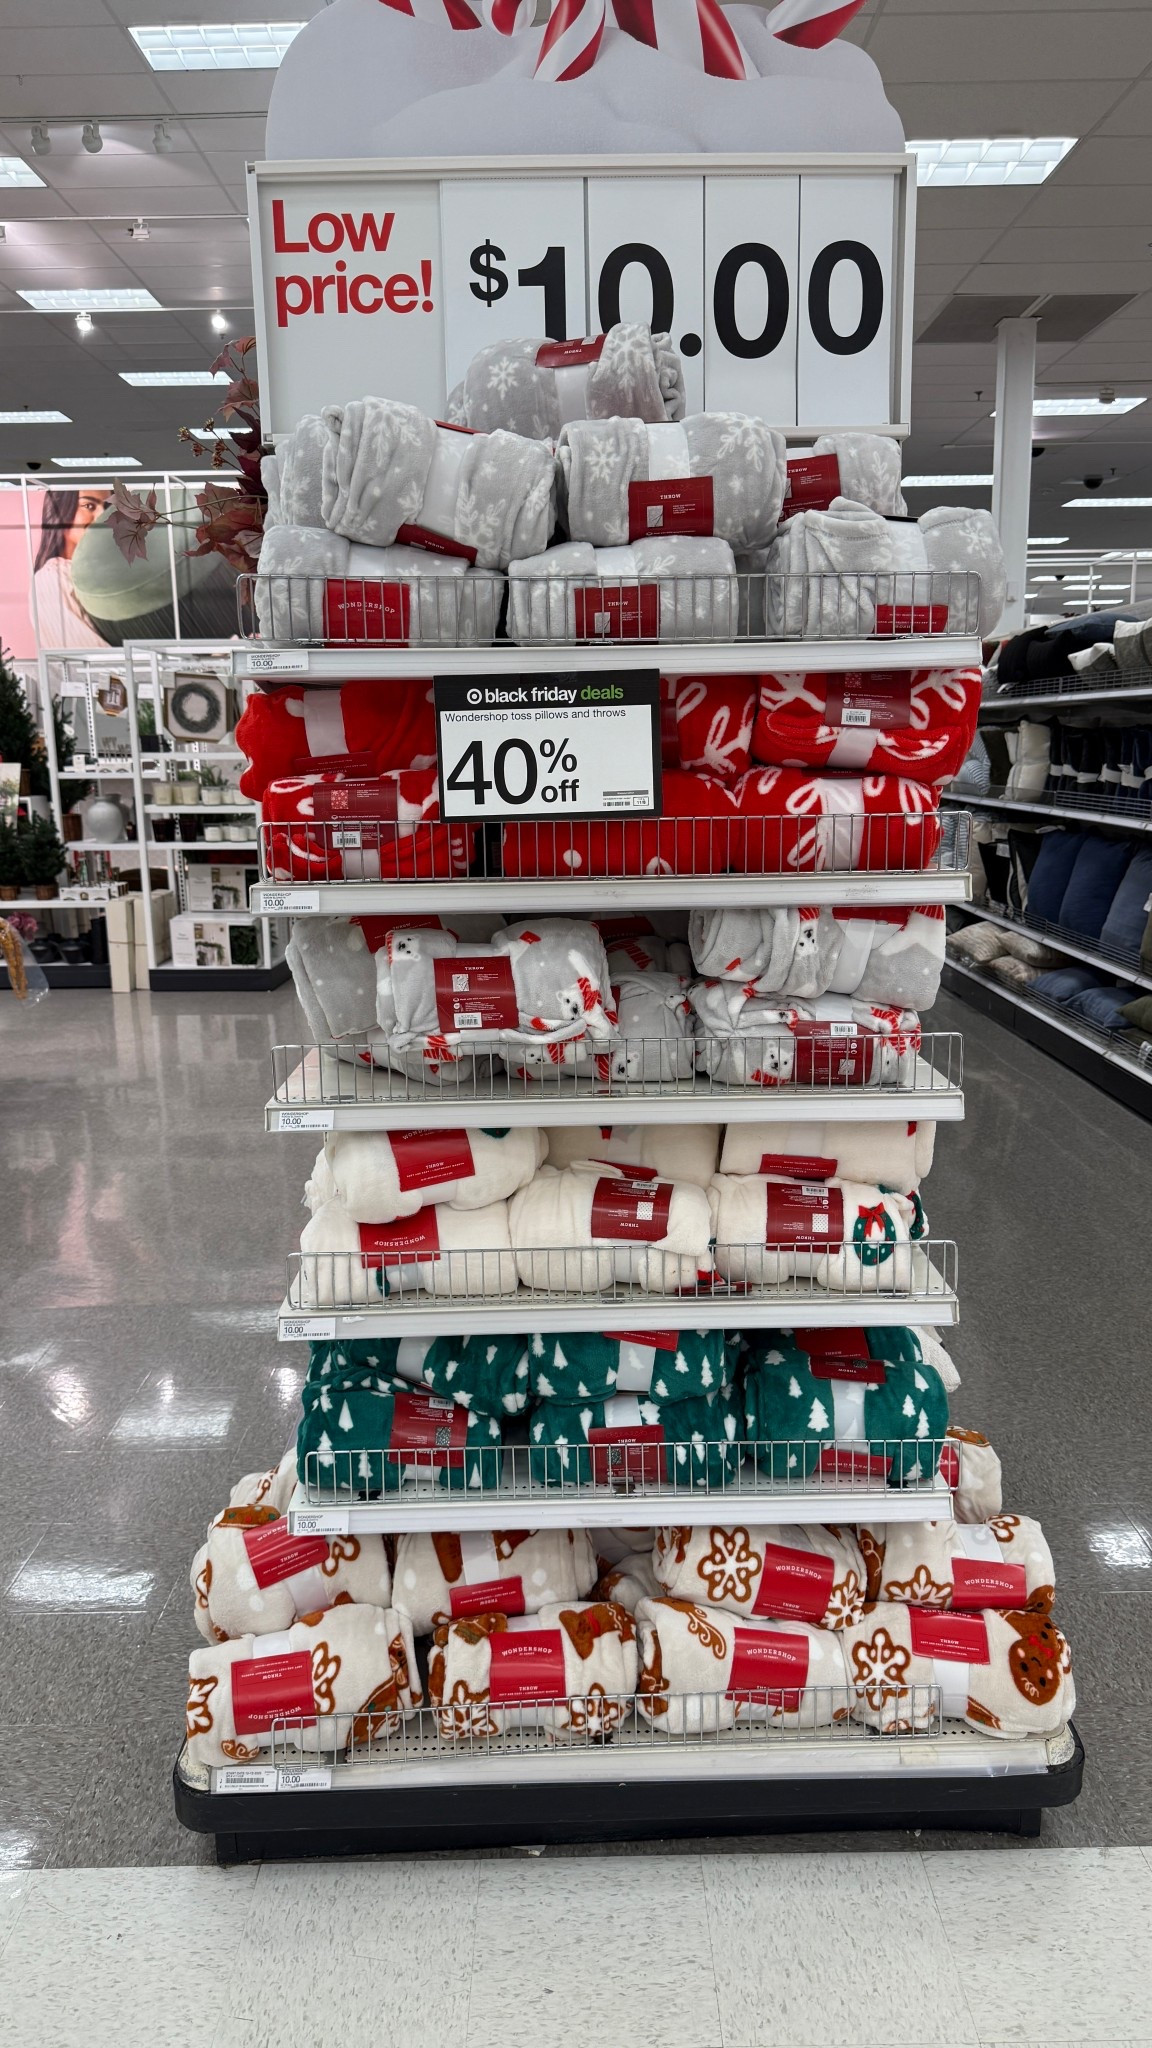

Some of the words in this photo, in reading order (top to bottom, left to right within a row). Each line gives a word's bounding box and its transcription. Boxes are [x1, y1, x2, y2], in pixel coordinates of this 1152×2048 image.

[271, 199, 395, 253] Low
[275, 259, 433, 327] price!
[469, 238, 884, 359] $10.00
[484, 688, 528, 704] black
[530, 686, 578, 704] friday
[580, 684, 624, 700] deals
[444, 712, 509, 723] Wondershop
[510, 712, 532, 721] toss
[534, 709, 569, 721] pillows
[571, 709, 590, 720] and
[592, 708, 626, 718] throws
[540, 778, 580, 802] off
[425, 1162, 444, 1170] THROW
[374, 1234, 426, 1246] WONDERSHOP
[280, 1552, 299, 1562] THROW
[776, 1566, 822, 1580] WONDERSHOP
[964, 1578, 1014, 1590] WONDERSHOP
[921, 1610, 972, 1618] WONDERSHOP
[502, 1646, 552, 1656] WONDERSHOP
[746, 1648, 796, 1662] WONDERSHOP
[248, 1706, 302, 1720] WONDERSHOP
